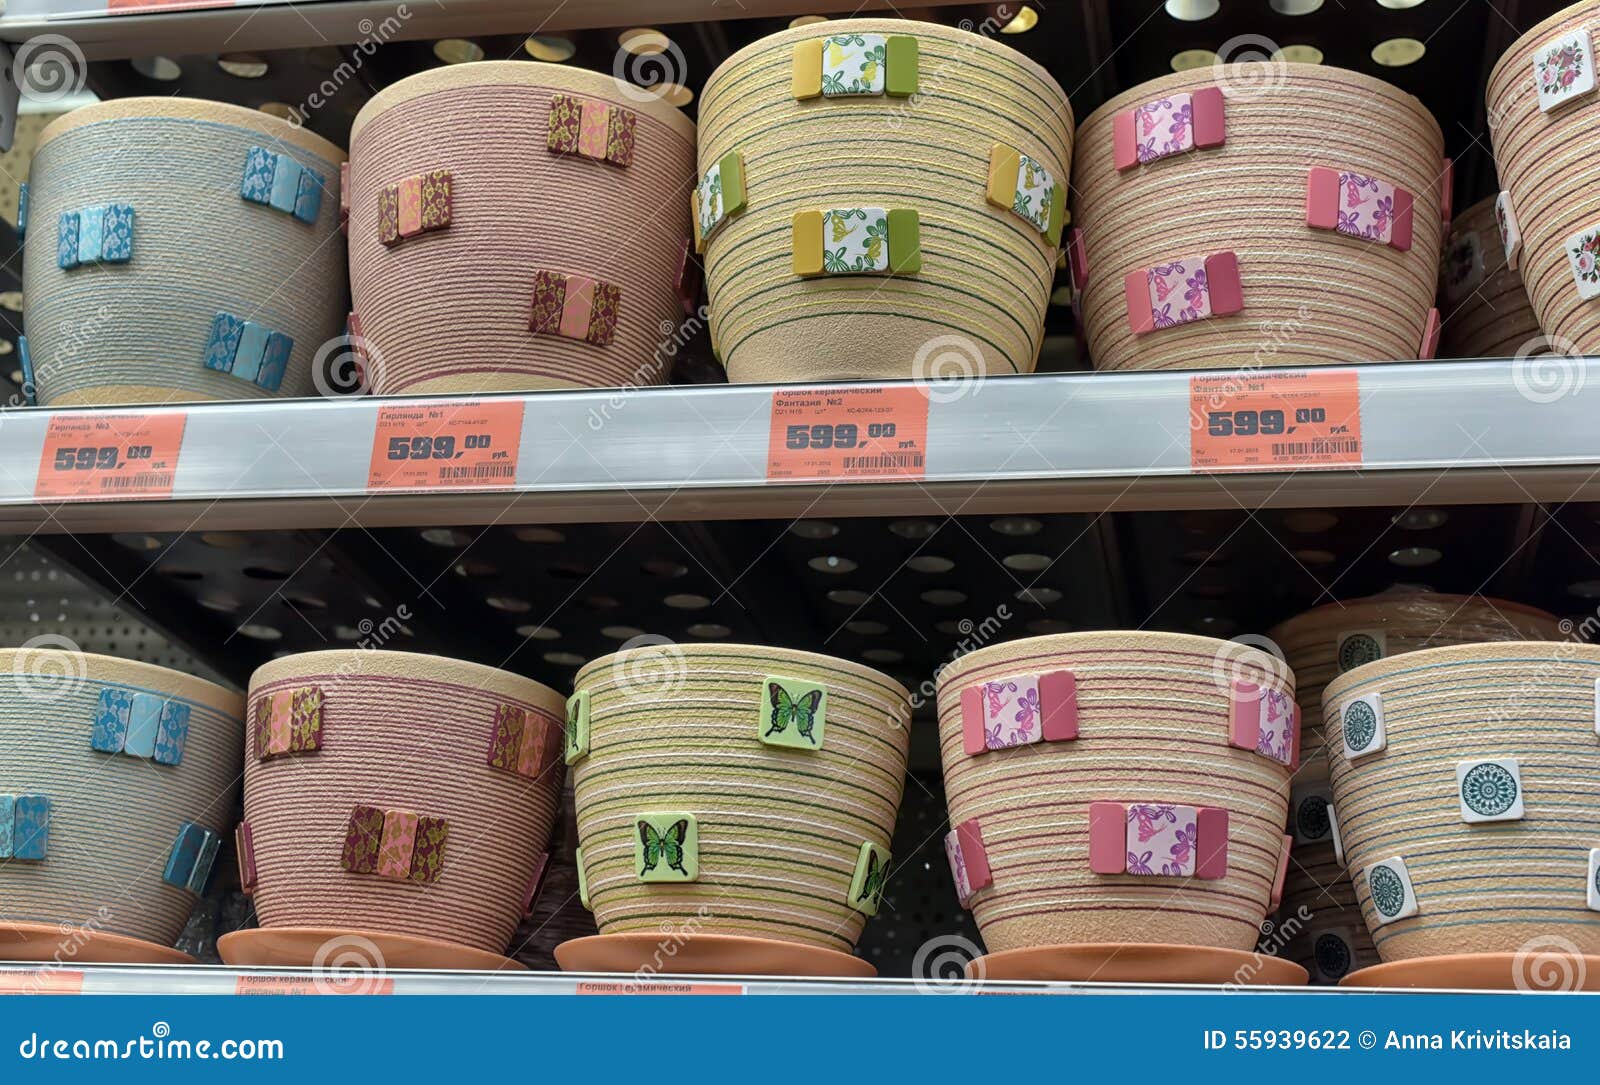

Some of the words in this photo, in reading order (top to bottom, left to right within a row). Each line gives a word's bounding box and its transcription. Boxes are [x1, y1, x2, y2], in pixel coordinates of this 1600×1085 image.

[776, 399, 821, 407] Фантазия
[826, 398, 843, 406] №2
[380, 412, 424, 420] Гирлянда
[1329, 425, 1350, 434] руб.
[898, 440, 917, 449] руб.
[491, 451, 509, 459] руб.
